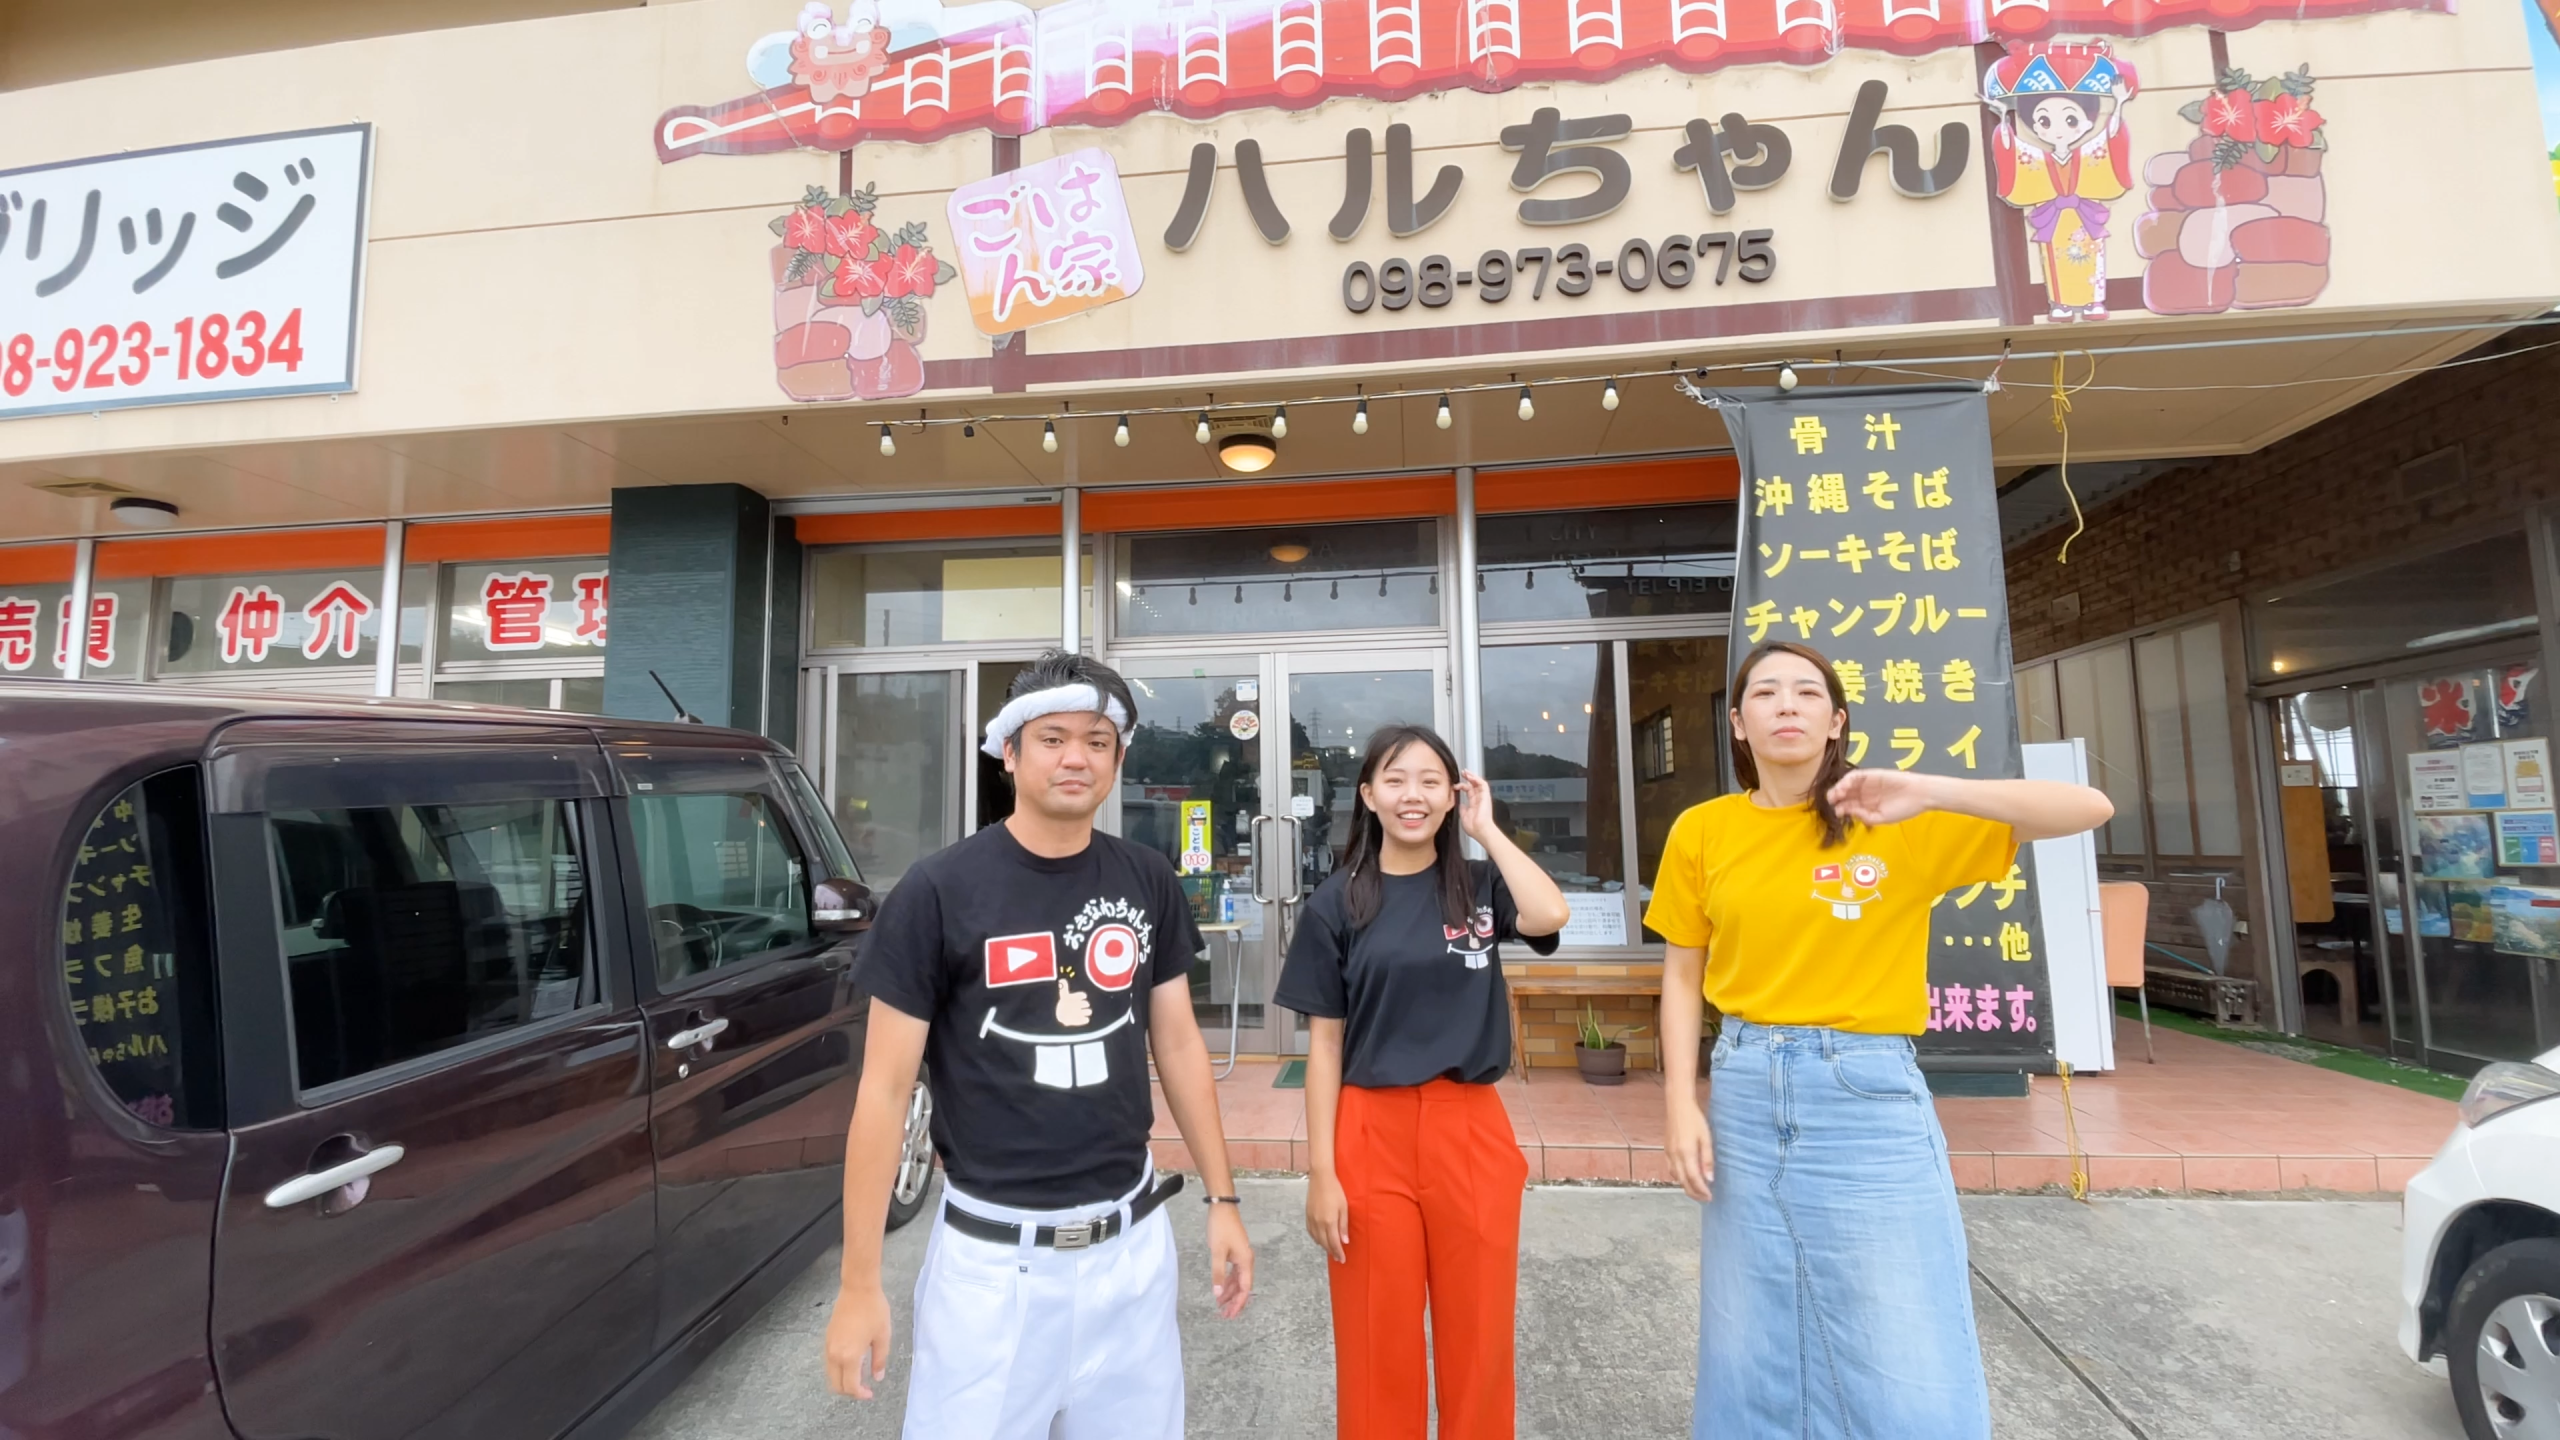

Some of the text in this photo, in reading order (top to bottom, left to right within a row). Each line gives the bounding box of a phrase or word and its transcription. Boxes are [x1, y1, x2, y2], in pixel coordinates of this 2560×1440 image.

[1163, 79, 1970, 254] ハルちゃん
[1342, 229, 1777, 312] 098-973-0675
[0, 308, 303, 397] 8-923-1834
[1755, 466, 1953, 517] 沖縄そば
[1758, 527, 1961, 578] ソーキそば
[223, 585, 367, 657] 仲介
[1744, 591, 1987, 643] チャンプルー
